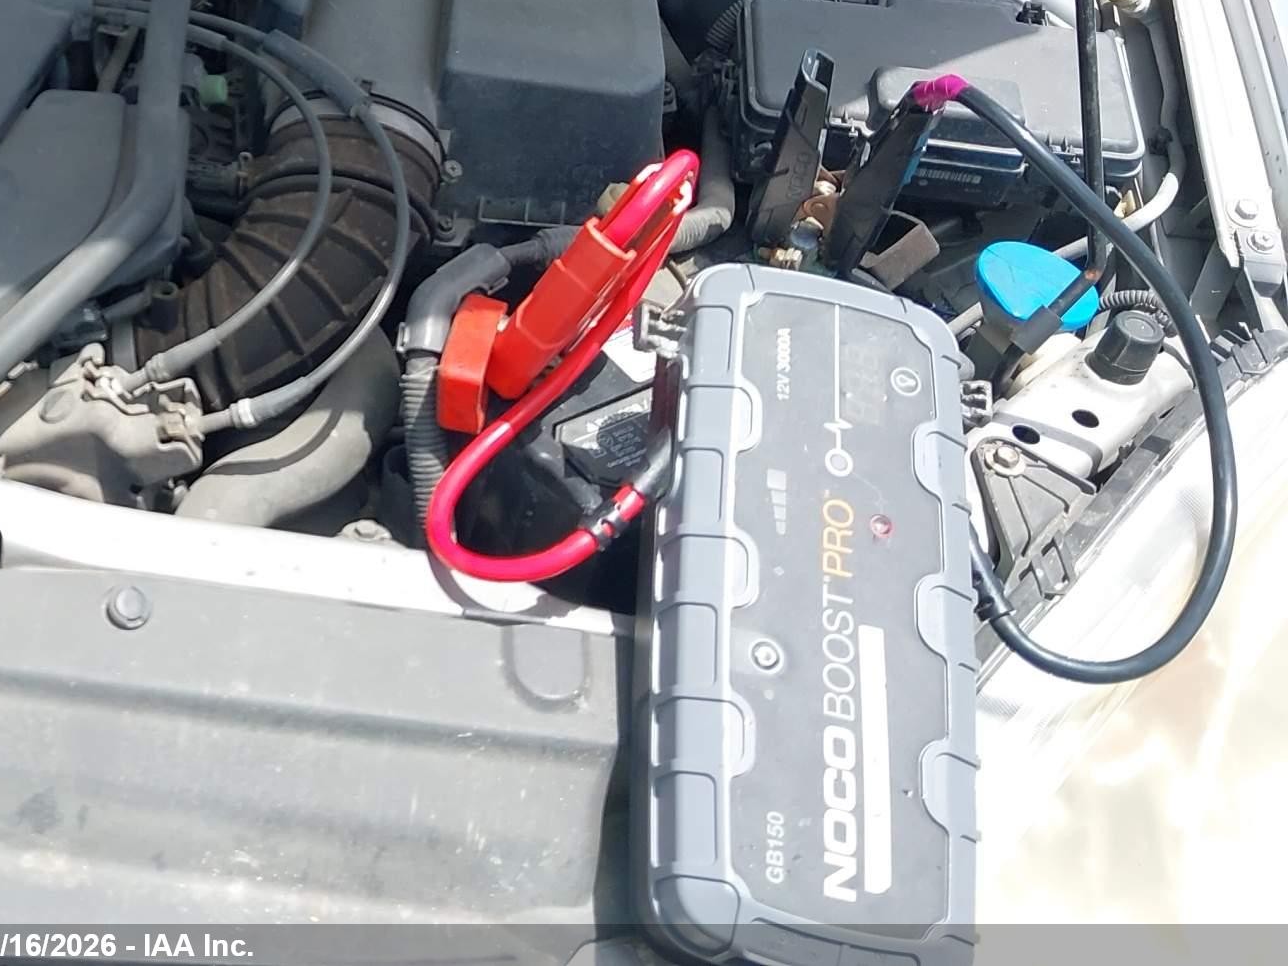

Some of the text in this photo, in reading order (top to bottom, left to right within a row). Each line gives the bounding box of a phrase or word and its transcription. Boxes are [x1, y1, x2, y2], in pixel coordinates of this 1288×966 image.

[777, 328, 791, 401] 12V 3000A
[822, 498, 857, 902] NOCO BOOST PRO
[765, 810, 785, 884] GB150
